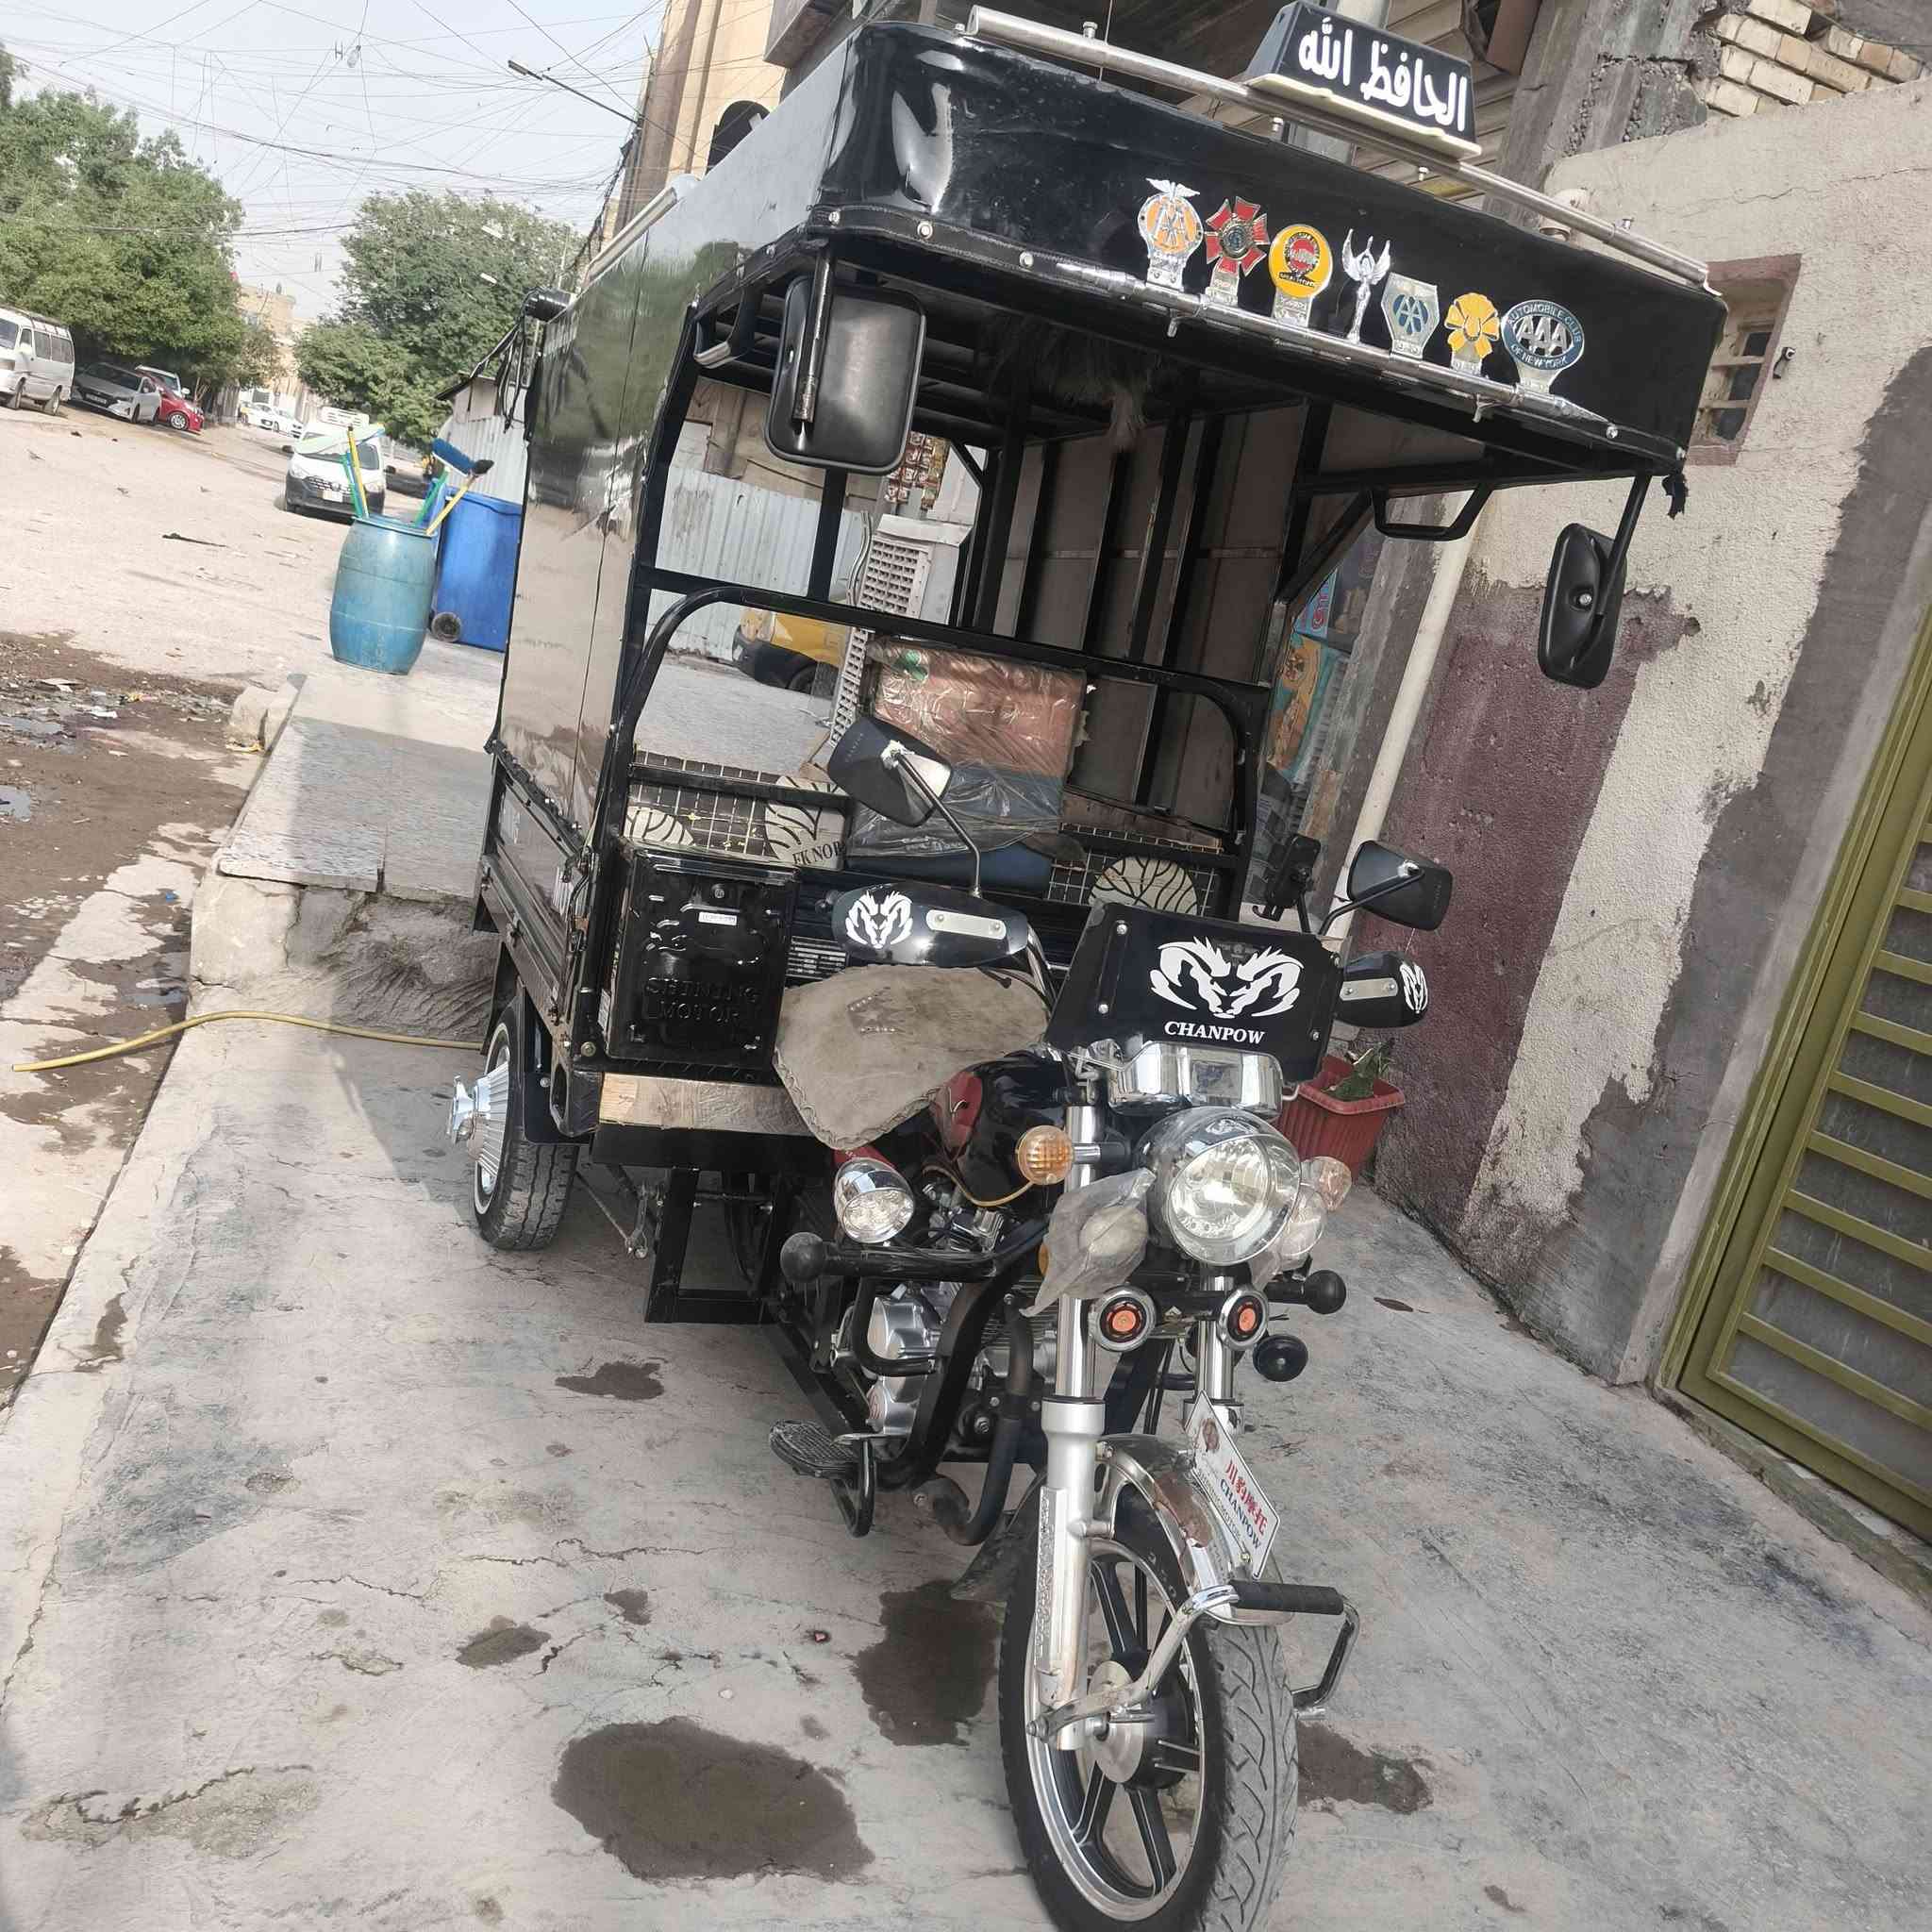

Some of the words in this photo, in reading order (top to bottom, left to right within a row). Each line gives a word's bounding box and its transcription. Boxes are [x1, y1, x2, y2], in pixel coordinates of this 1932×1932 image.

[1298, 17, 1354, 87] الله
[1359, 40, 1468, 132] الحافظ
[1395, 295, 1424, 334] AA
[1507, 304, 1565, 325] AUTOMOBILE
[1564, 316, 1582, 342] CLUB
[1510, 343, 1524, 357] OF
[1524, 353, 1544, 368] NEW
[1516, 314, 1568, 357] AAA
[1164, 1021, 1266, 1044] CHANPOW
[1220, 1478, 1262, 1550] CHANPOW
